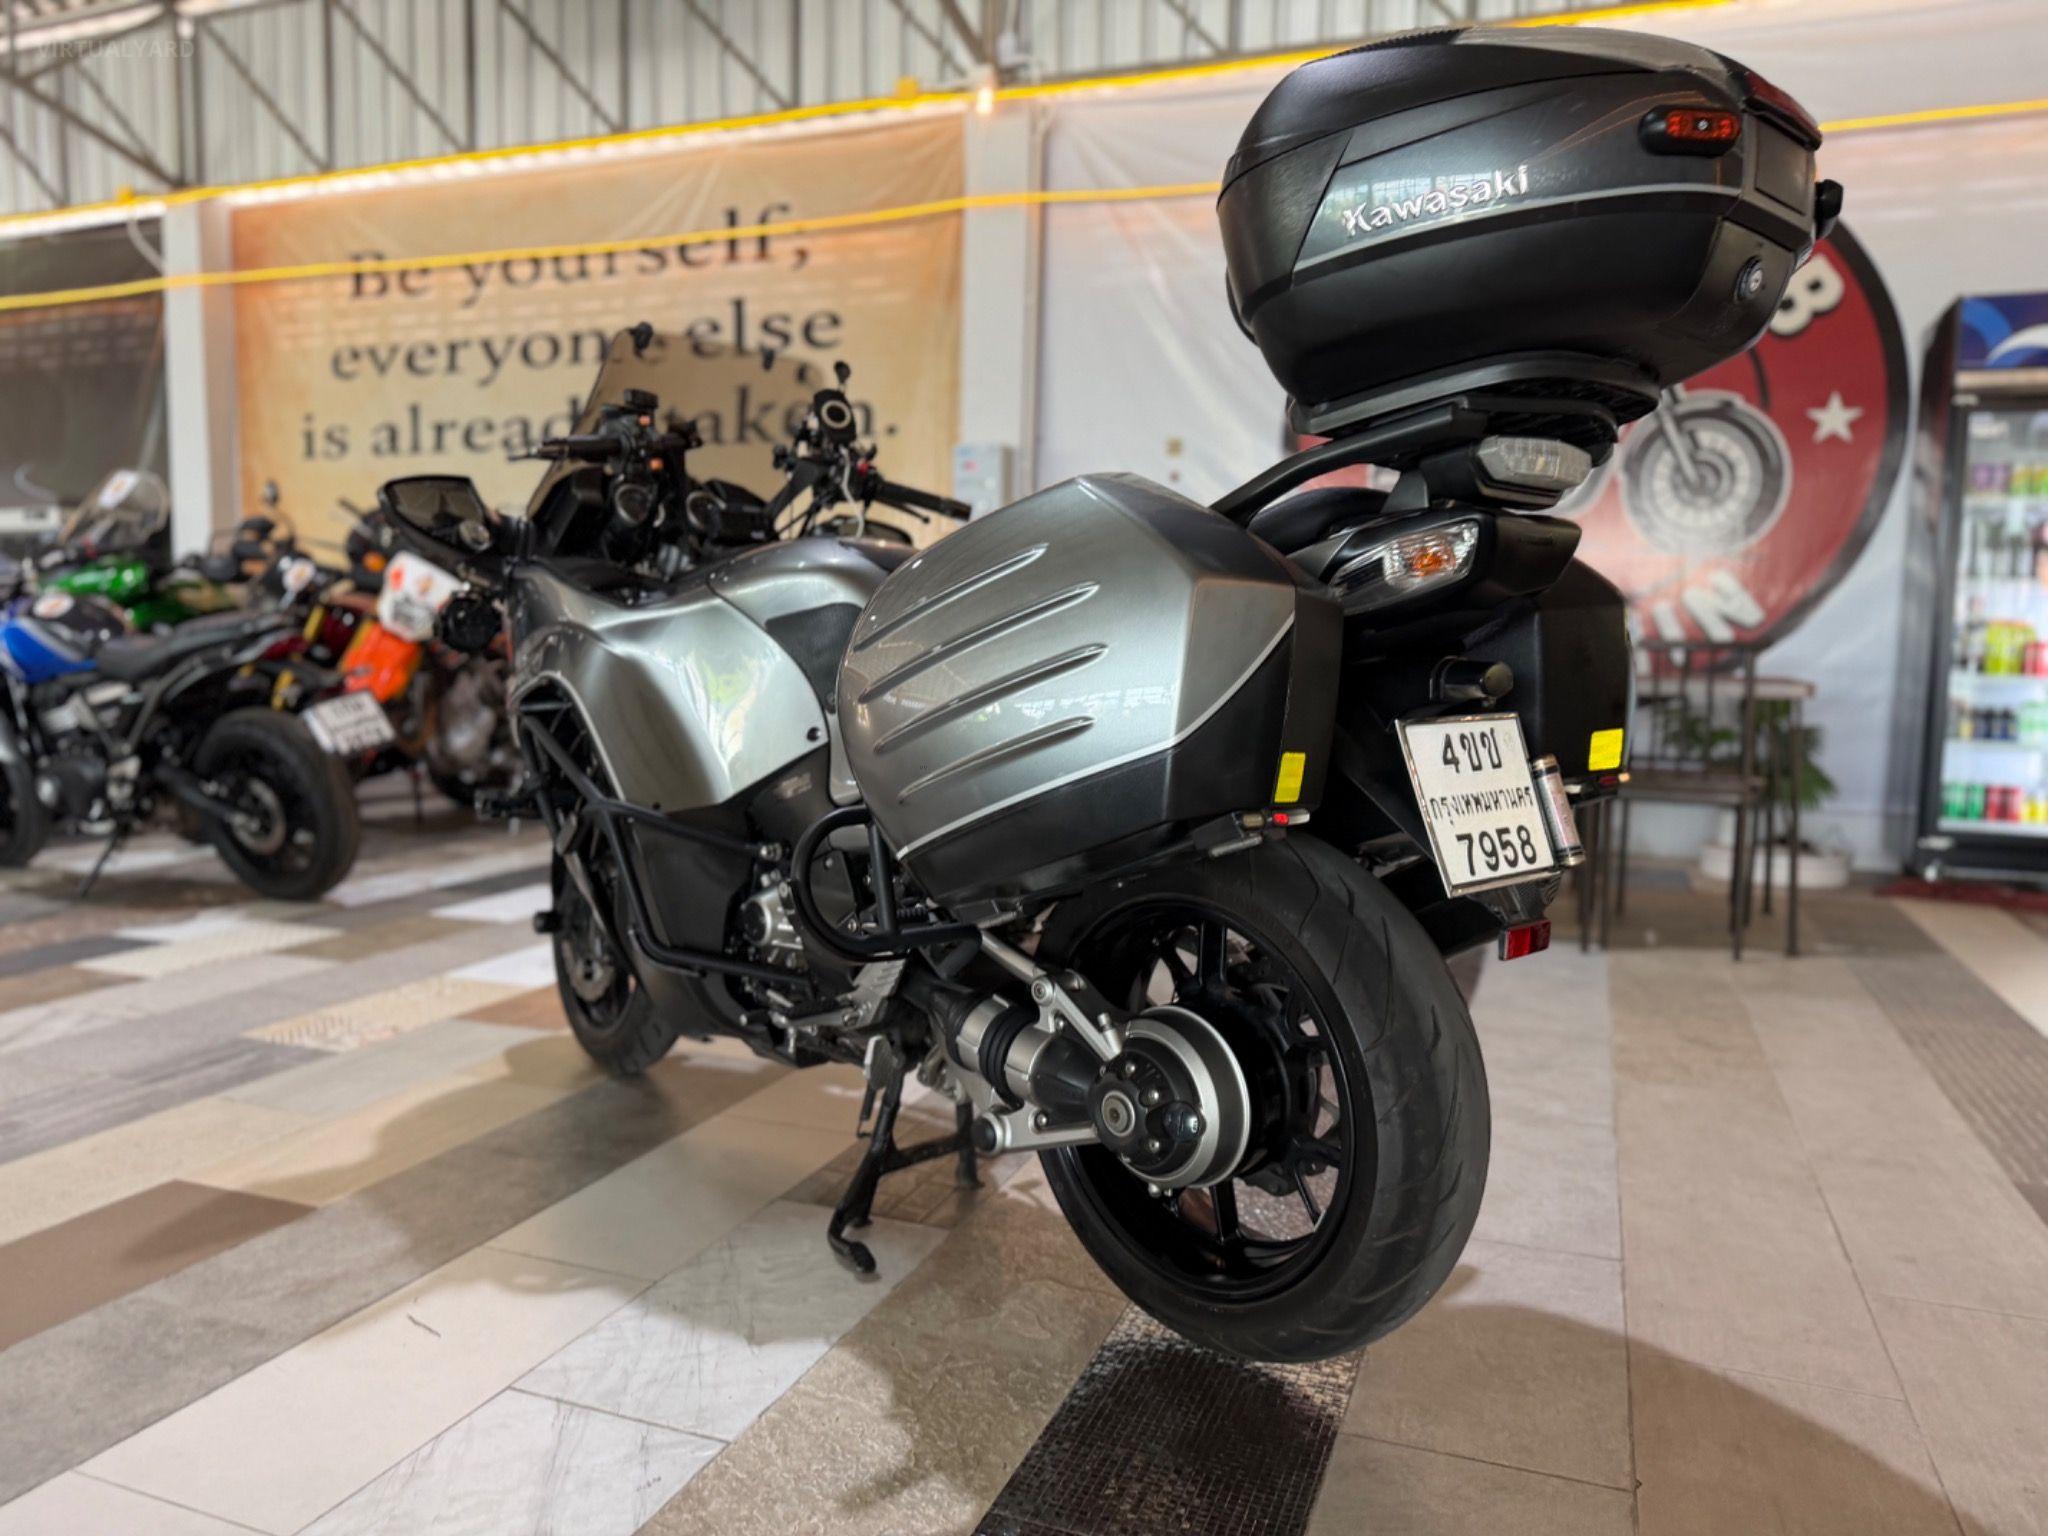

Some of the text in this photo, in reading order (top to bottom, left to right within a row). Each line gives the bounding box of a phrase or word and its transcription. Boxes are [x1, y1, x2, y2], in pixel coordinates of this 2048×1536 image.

[1341, 163, 1530, 238] Kawasaki
[348, 203, 810, 307] Be yourself,
[687, 298, 843, 357] else
[302, 414, 349, 459] is
[371, 396, 582, 458] alread
[1455, 824, 1537, 877] 7958
